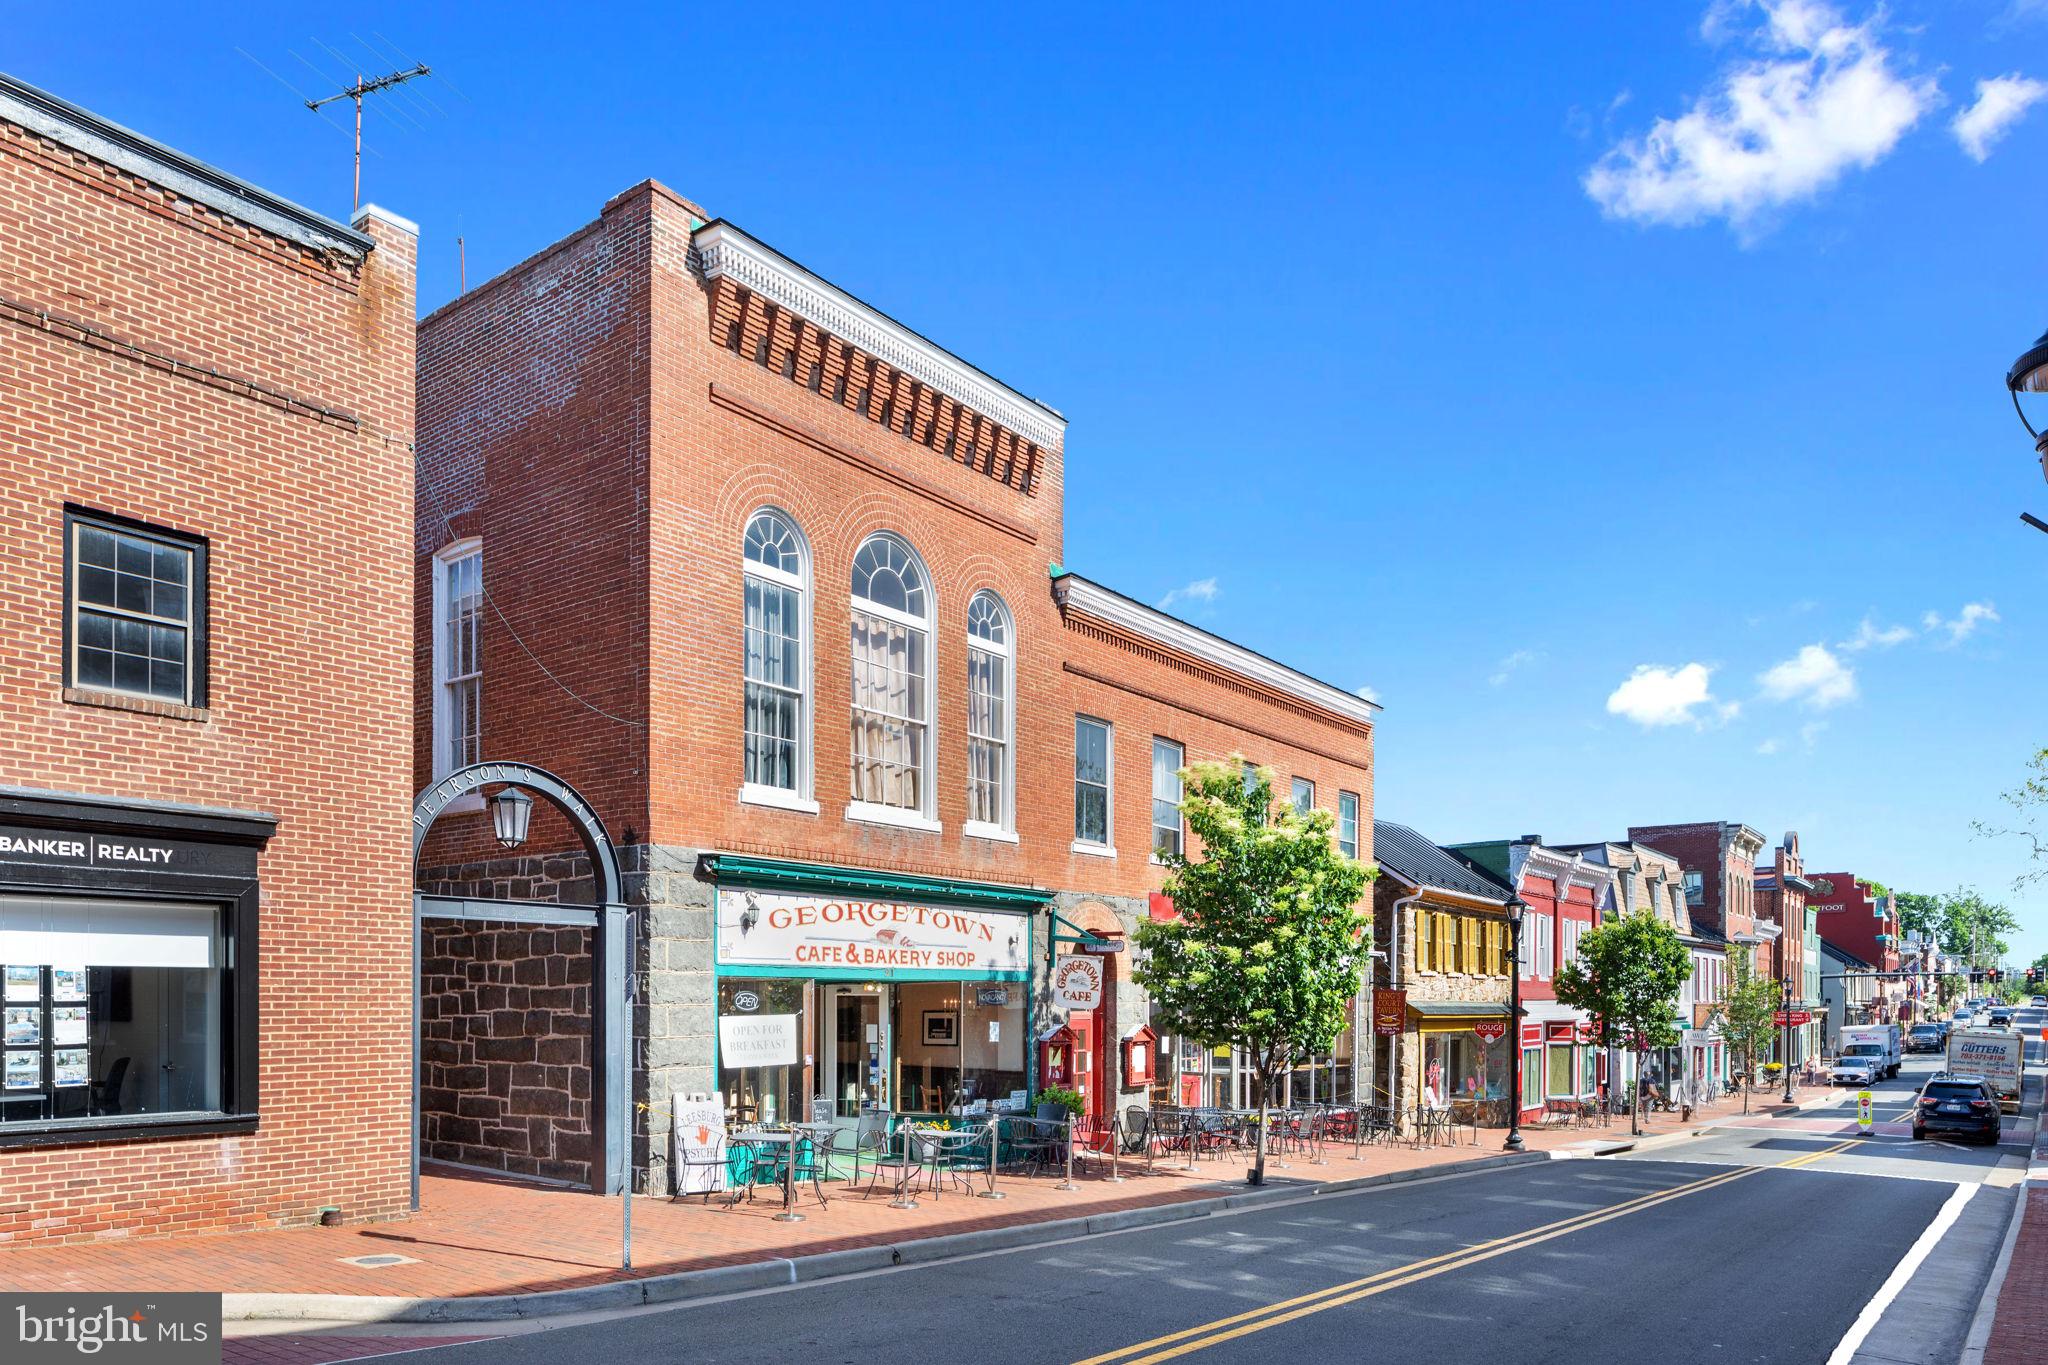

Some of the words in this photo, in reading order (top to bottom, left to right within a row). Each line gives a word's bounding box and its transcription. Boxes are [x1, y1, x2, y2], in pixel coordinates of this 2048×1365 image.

[412, 764, 532, 829] PEARSON'S
[561, 786, 607, 847] WALK
[0, 836, 85, 857] BANKER
[98, 844, 173, 863] REALTY
[769, 902, 996, 942] GEORGETOWN
[796, 945, 842, 963] CAFE
[864, 948, 932, 967] BAKERY
[936, 951, 976, 967] SHOP
[1057, 960, 1099, 991] GEORGETOWN
[737, 995, 758, 1008] OPEN
[1063, 990, 1092, 1002] CAFE
[732, 1025, 760, 1036] OPEN
[762, 1024, 783, 1035] FOR
[730, 1039, 787, 1053] BREAKFAST
[1961, 1043, 2007, 1054] GUTTERS
[682, 1110, 722, 1126] LEESBURG
